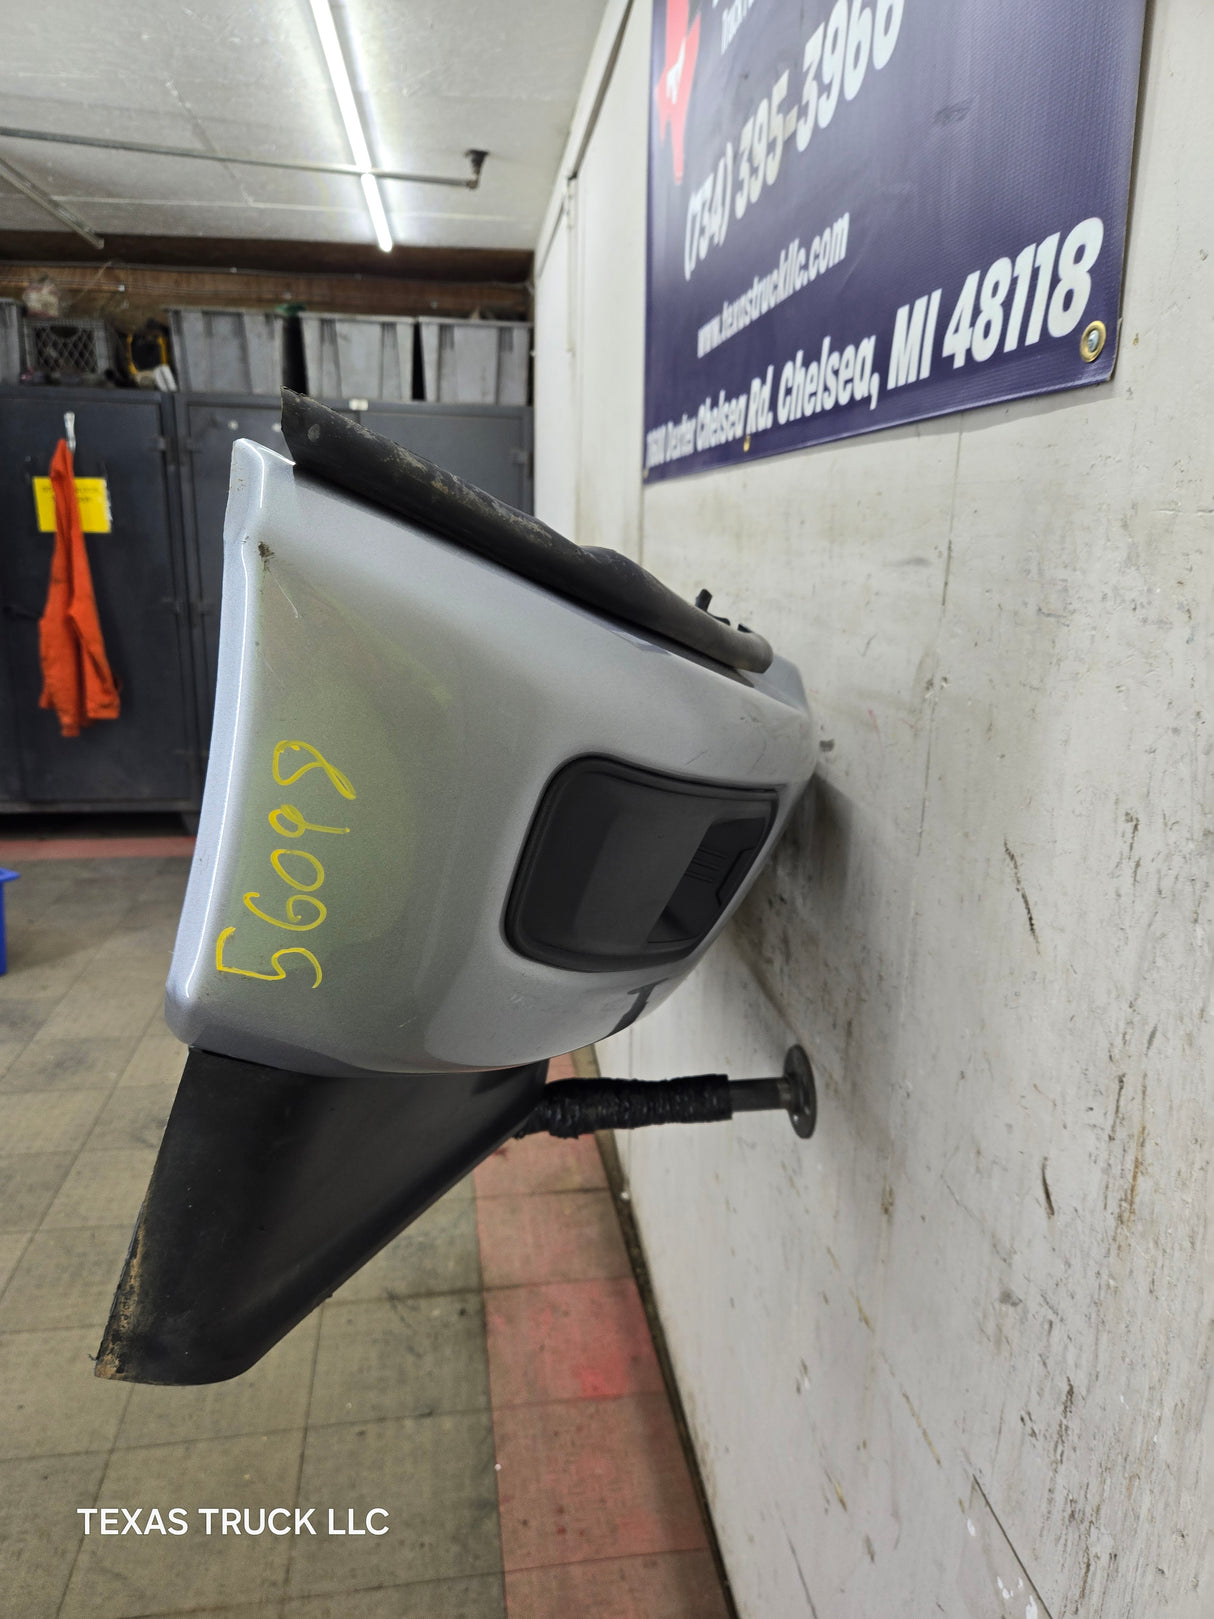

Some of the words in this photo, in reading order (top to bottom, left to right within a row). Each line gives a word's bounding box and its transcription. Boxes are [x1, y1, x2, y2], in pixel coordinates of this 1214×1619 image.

[684, 141, 734, 281] (734)
[696, 389, 748, 452] Chelsea
[745, 364, 775, 436] Rd.
[777, 335, 877, 411] Chelsea,
[887, 288, 943, 390] MI
[942, 217, 1104, 370] 48118
[215, 740, 356, 989] 56098
